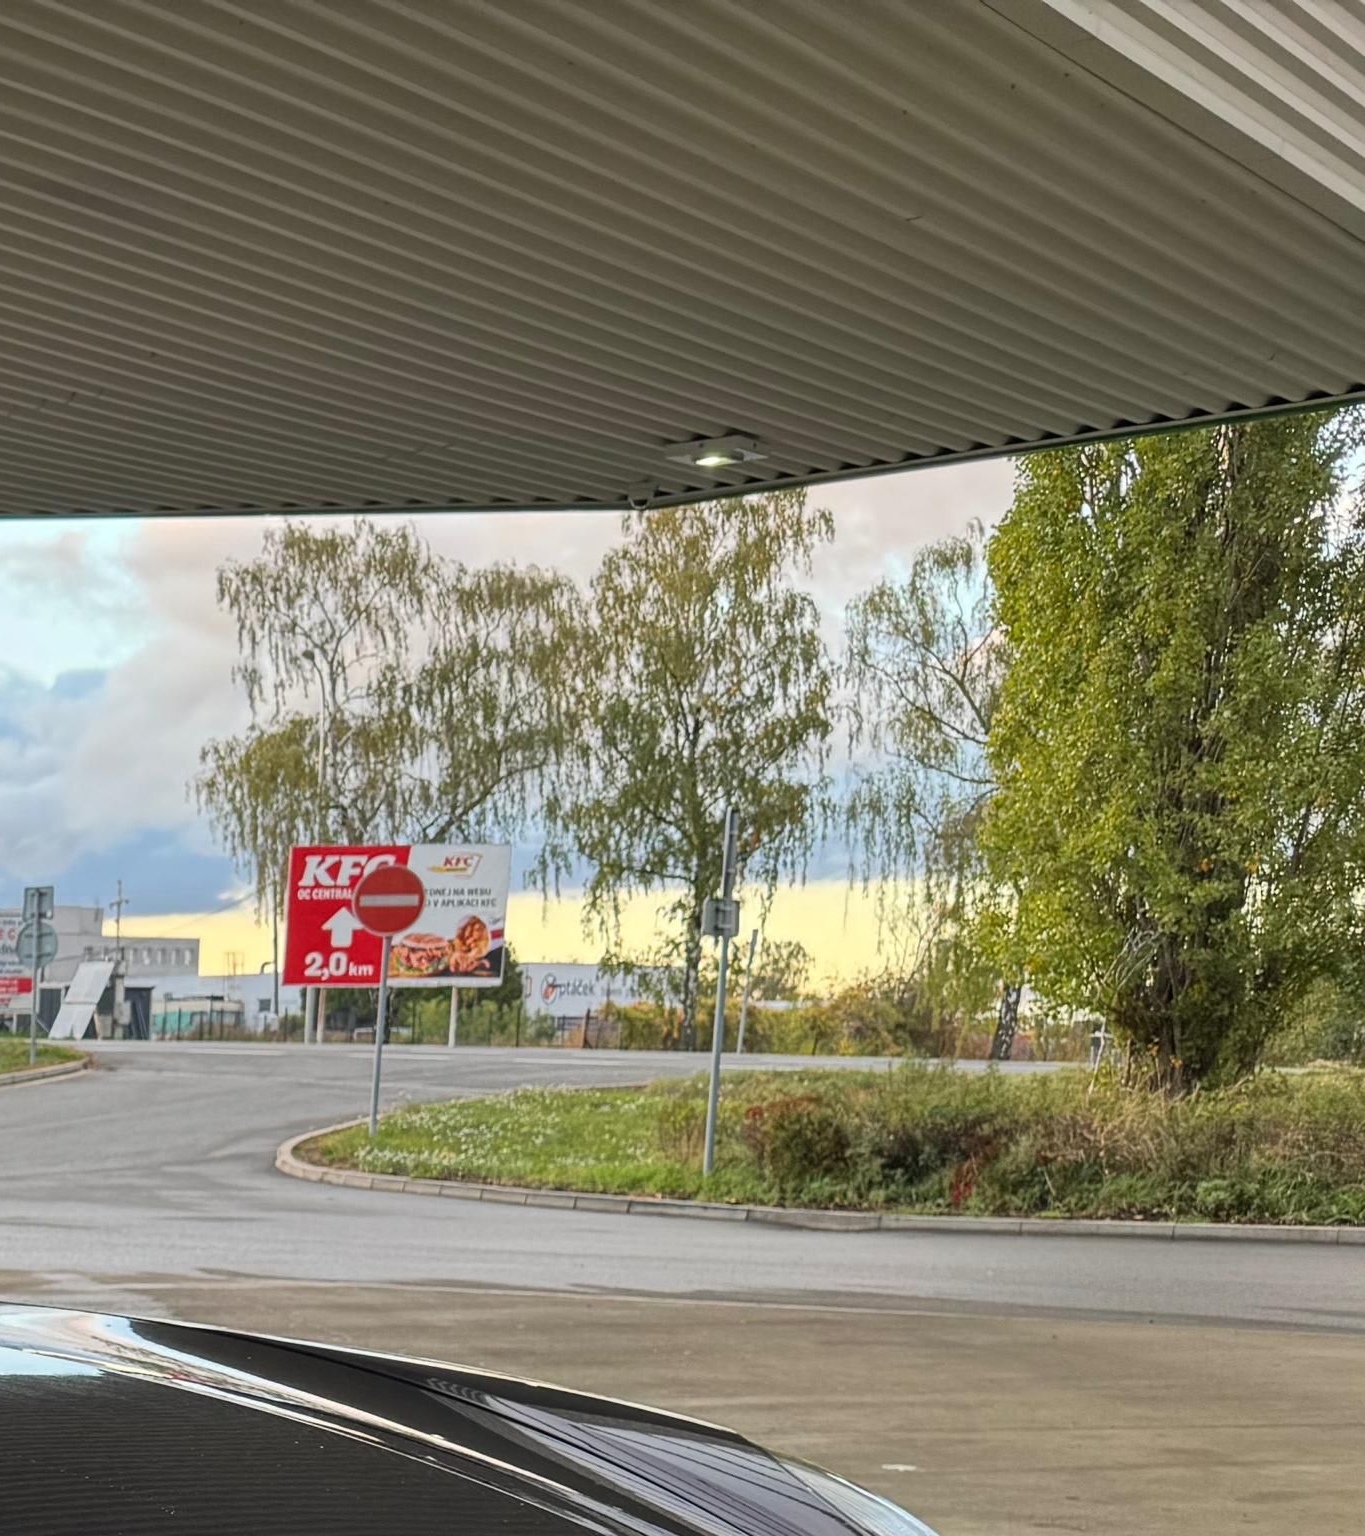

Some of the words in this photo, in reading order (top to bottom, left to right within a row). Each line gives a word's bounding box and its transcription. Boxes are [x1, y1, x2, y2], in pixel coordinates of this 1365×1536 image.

[312, 887, 353, 901] CENTRAL
[304, 951, 348, 981] 2,0
[349, 962, 374, 976] km
